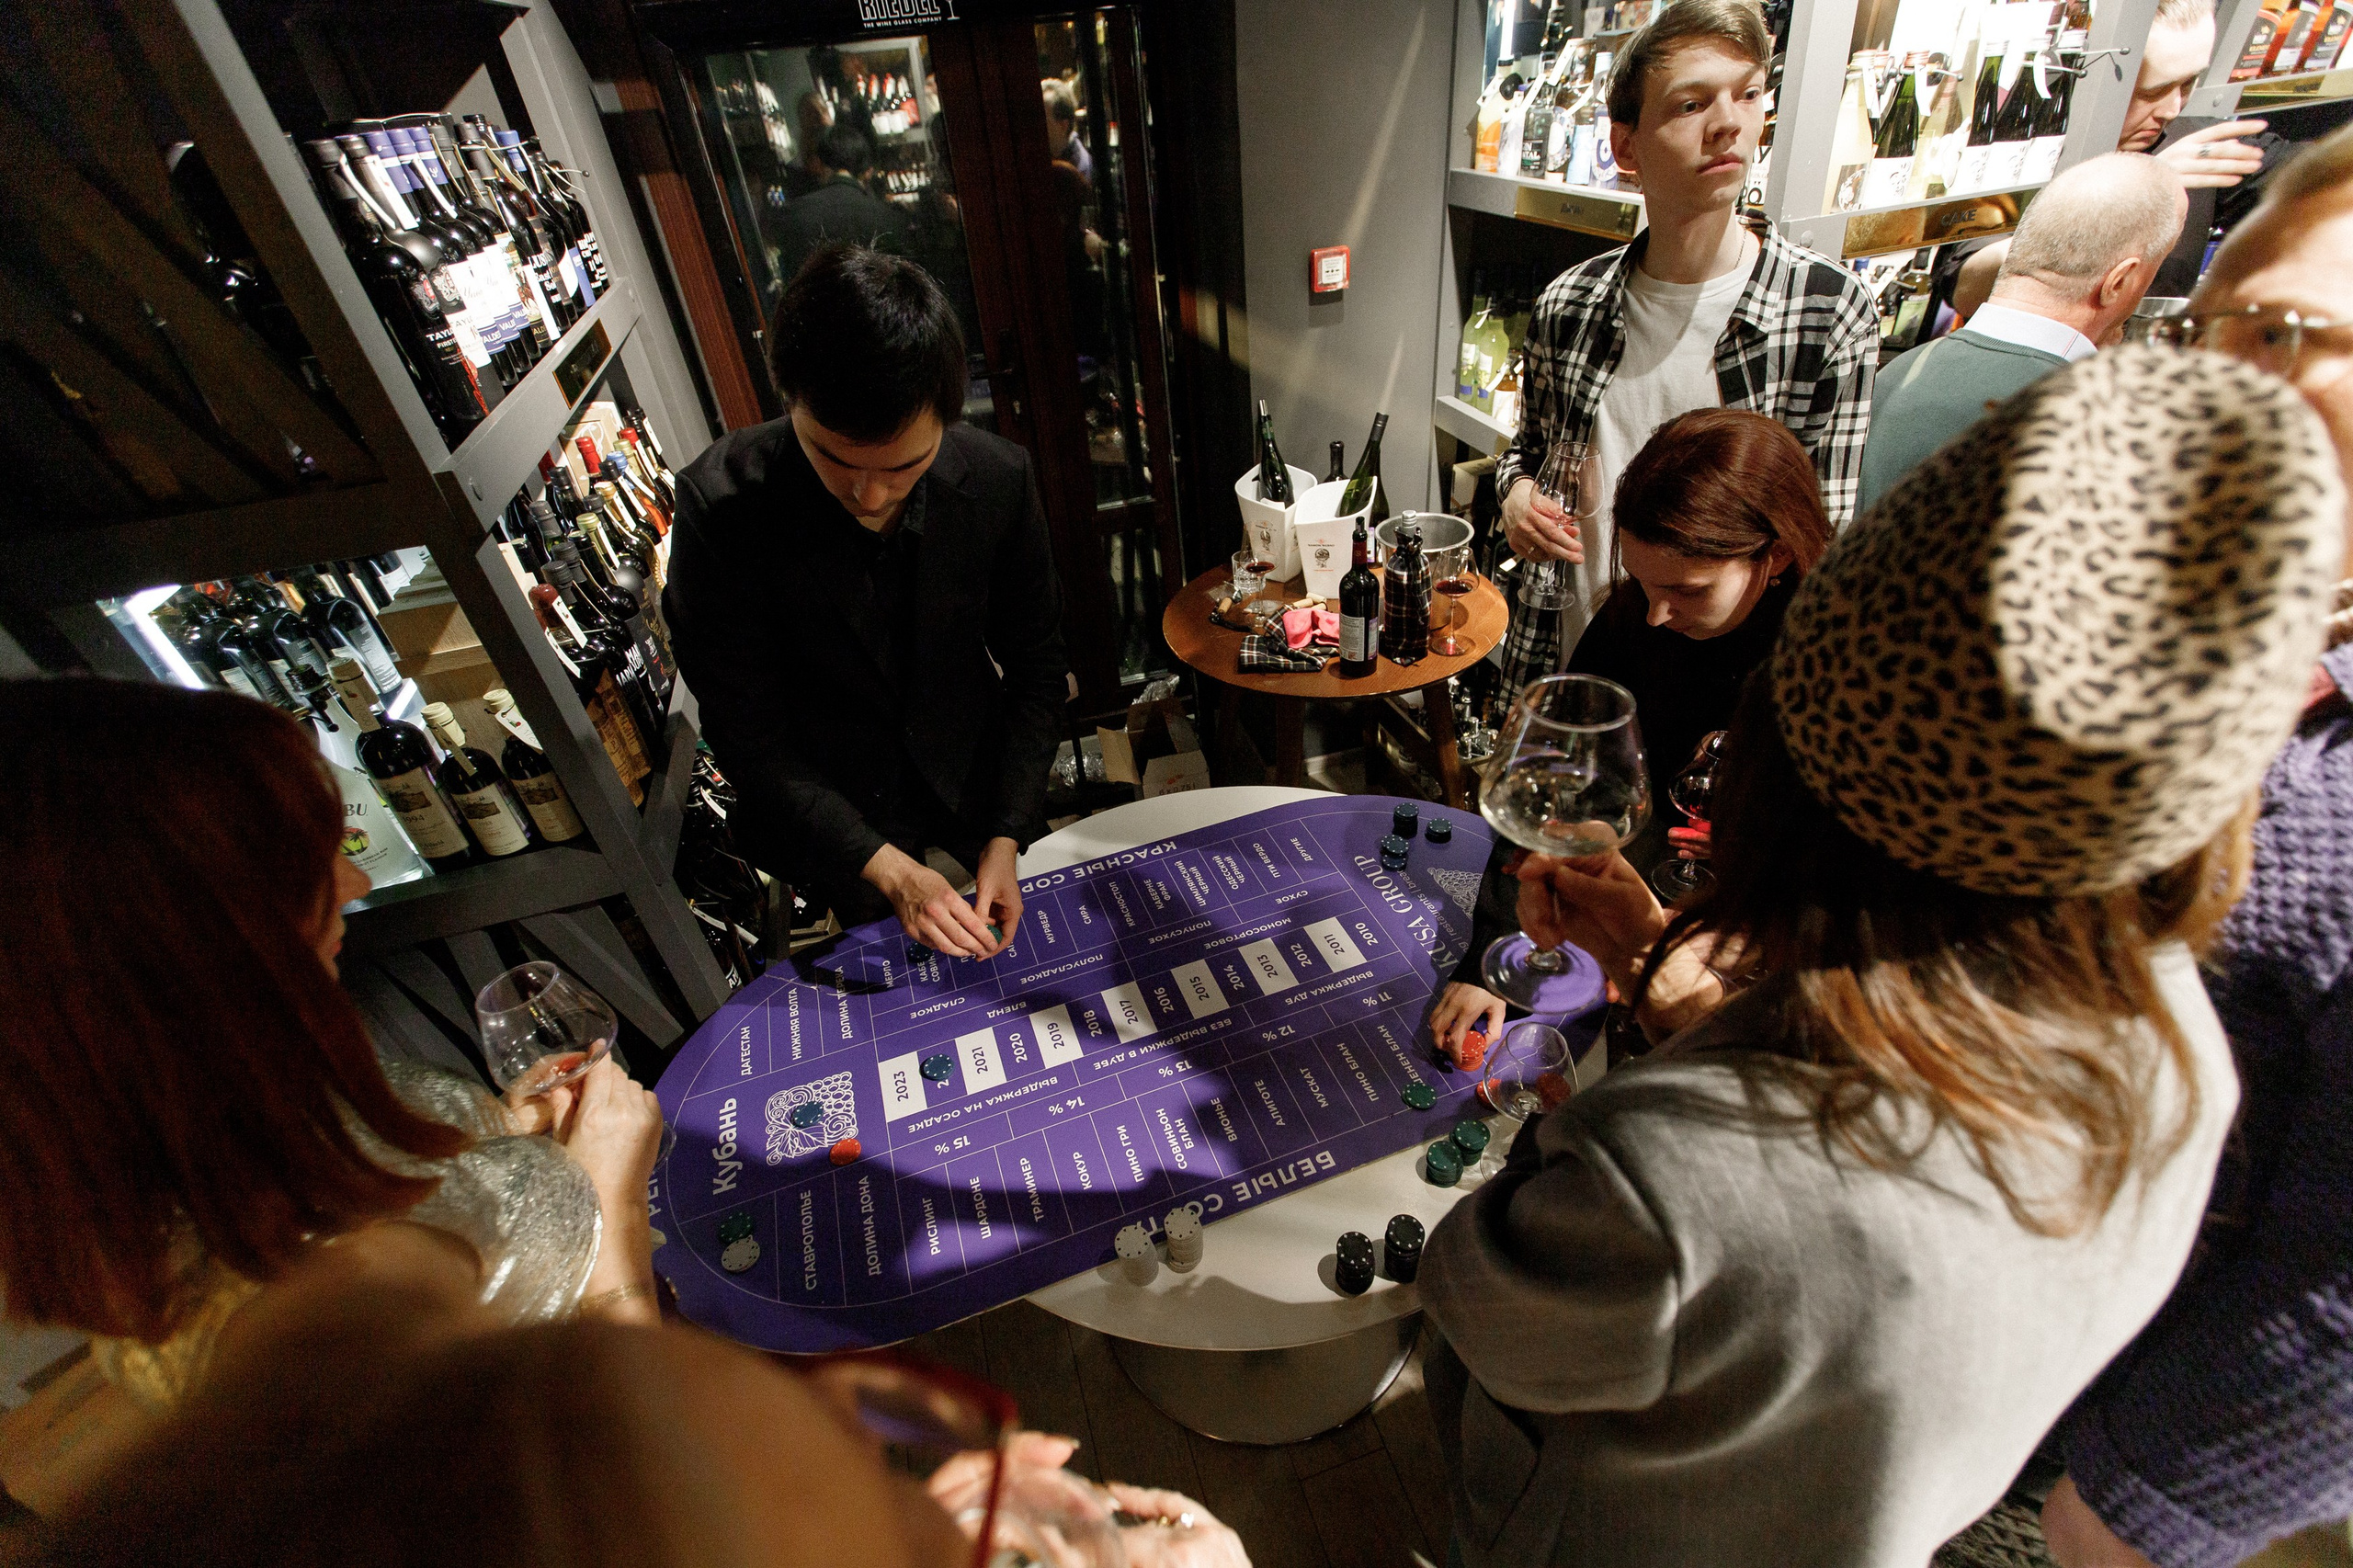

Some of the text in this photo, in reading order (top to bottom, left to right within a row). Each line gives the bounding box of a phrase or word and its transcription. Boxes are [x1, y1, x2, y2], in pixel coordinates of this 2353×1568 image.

[1253, 843, 1281, 879] ПТИ ВЕРДО
[1290, 837, 1314, 861] ДРУГИЕ
[1022, 841, 1177, 893] КРАСНЫЕ СОР
[1175, 860, 1207, 906] ЦИМЛЯНСКИЙ
[1189, 866, 1210, 894] ЧЕРНЫЙ
[1212, 855, 1239, 890] ОДЕССКИЙ
[1224, 856, 1245, 884] ЧЕРНЫЙ
[1143, 878, 1165, 910] КАБЕРНЕ
[1156, 881, 1172, 902] ФРАН
[1276, 890, 1309, 904] СУХОЕ
[1354, 855, 1413, 914] GROUP
[1079, 904, 1092, 925] СИРА
[1108, 881, 1136, 927] КРАСНОСТОП
[1417, 893, 1457, 937] restaurants
[1038, 910, 1055, 944] МУРВЕДР
[1148, 920, 1211, 945] ПОЛУСУХОЕ
[1203, 917, 1291, 950] МОНОСОРТОВОЕ
[1355, 922, 1379, 946] 2010
[1290, 943, 1313, 968] 2012
[1324, 933, 1346, 956] 2011
[883, 960, 894, 988] МЕРЛО
[1020, 953, 1104, 985] ПОЛУСЛАДКОЕ
[1223, 964, 1245, 991] 2014
[1256, 953, 1279, 979] 2013
[835, 966, 853, 1040] ДОЛИНА ТЕРЕКА
[1154, 987, 1175, 1014] 2016
[1189, 975, 1211, 1002] 2015
[1284, 970, 1374, 1005] ВЫДЕРЖКА ДУБ
[1362, 991, 1392, 1006] 11 %
[909, 996, 965, 1019] СЛАДКОЕ
[986, 1001, 1027, 1019] БЛЕНД
[1083, 1009, 1103, 1038] 2018
[1120, 1000, 1139, 1025] 2017
[789, 988, 801, 1060] НИЖНЯЯ ВОЛГА
[1047, 1022, 1065, 1050] 2019
[1262, 1024, 1296, 1042] 12 %
[1377, 1025, 1401, 1053] БЛАН
[741, 1026, 753, 1075] ДАГЕСТАН
[972, 1046, 988, 1074] 2021
[1009, 1032, 1029, 1063] 2020
[1093, 1018, 1232, 1071] БЕЗ ВЫДЕРЖКИ В ДУБЕ
[1158, 1060, 1193, 1078] 13 %
[1336, 1042, 1380, 1102] ПИНО БЛАН
[893, 1071, 909, 1102] 2023
[1300, 1066, 1329, 1108] МУСКАТ
[907, 1076, 1058, 1133] ВЫДЕРЖКА НА ОСАДКЕ
[1048, 1096, 1086, 1116] 14 %
[1211, 1096, 1238, 1142] ВИОНЬЕ
[1255, 1079, 1286, 1127] АЛИГОТЕ
[712, 1098, 743, 1195] Кубань
[934, 1134, 972, 1155] 15 %
[1155, 1108, 1188, 1170] СОВИНЬОН
[1174, 1118, 1195, 1150] БЛАН
[1116, 1125, 1145, 1183] ПИНО ГРИ
[1073, 1152, 1093, 1190] КОКУР
[1232, 1150, 1336, 1202] БЕЛЫЕ
[1019, 1157, 1045, 1222] ТРАМИНЕР
[970, 1176, 992, 1240] ШАРДОНЕ
[801, 1189, 818, 1290] СТАВРОПОЛЬЕ
[858, 1176, 881, 1276] ДОЛИНА ДОНА
[922, 1197, 941, 1256] РИСЛИНГ
